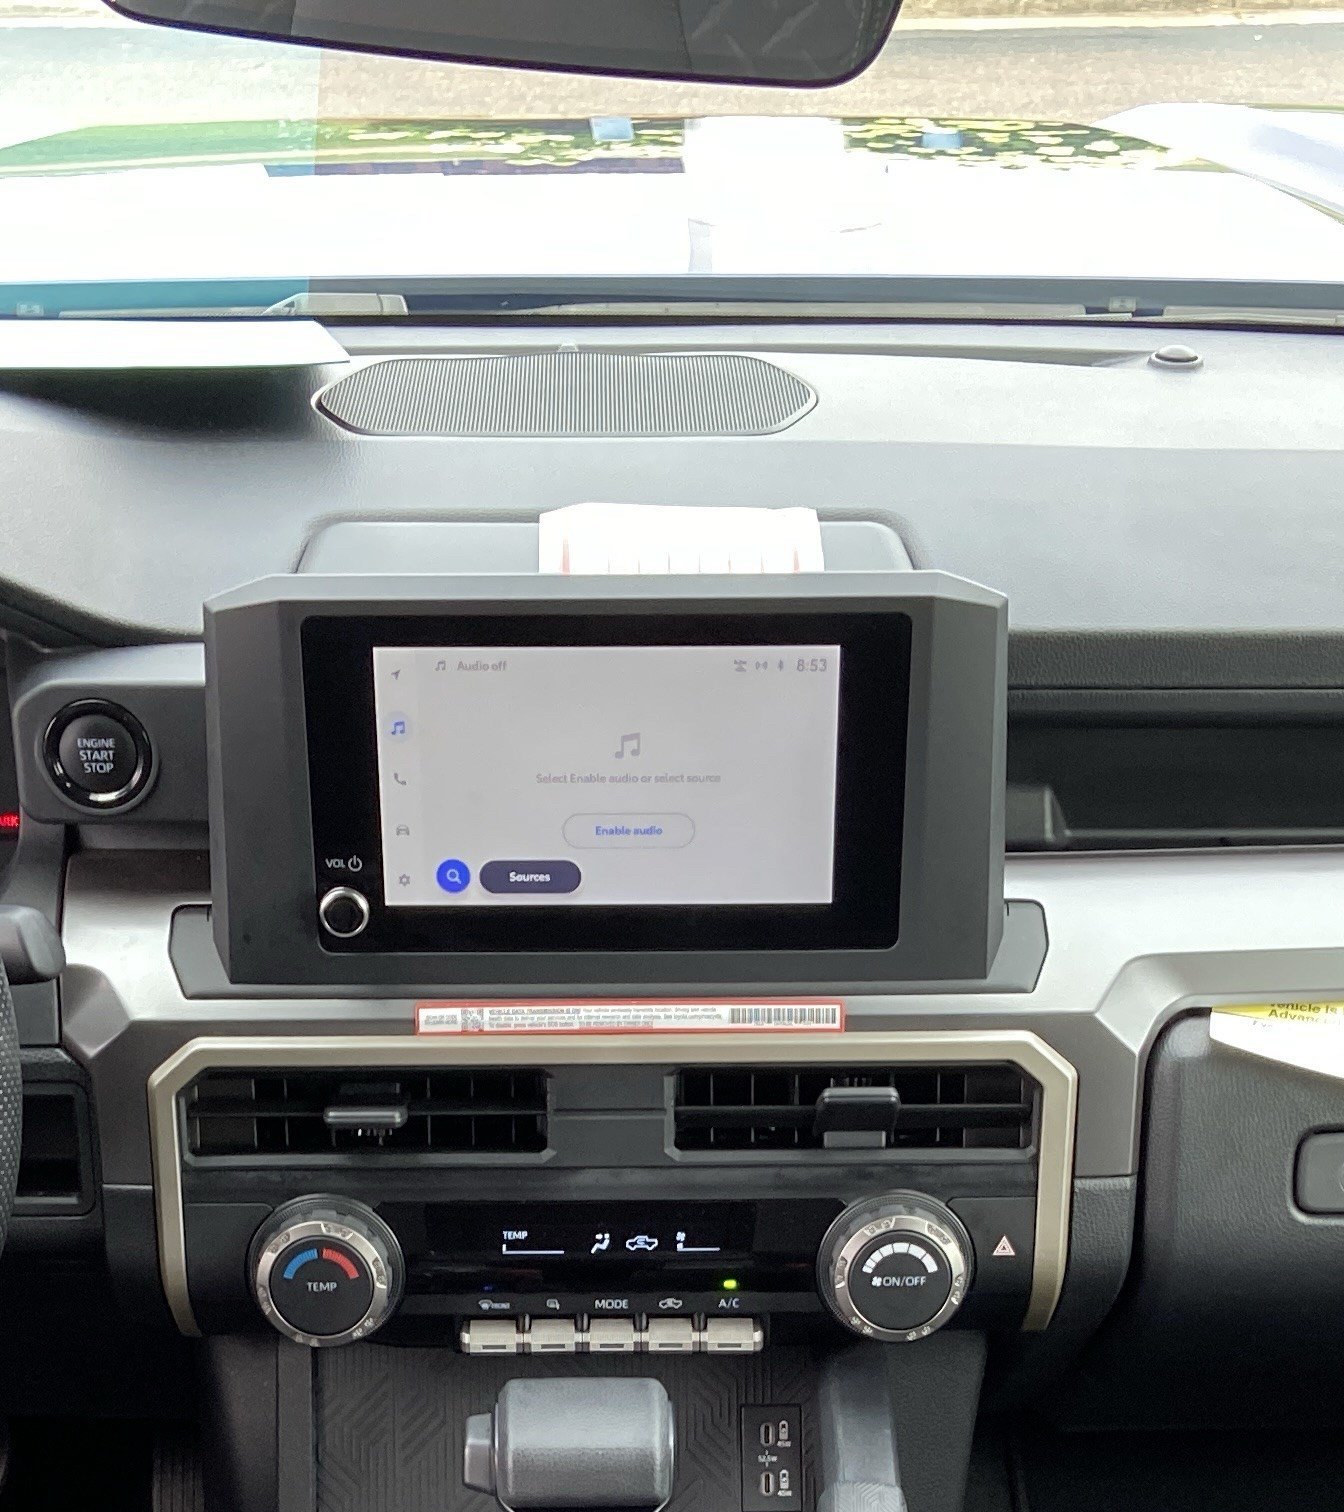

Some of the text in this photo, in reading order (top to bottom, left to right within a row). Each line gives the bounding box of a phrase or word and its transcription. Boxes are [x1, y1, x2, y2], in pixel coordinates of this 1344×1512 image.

[457, 660, 508, 671] Audio off
[77, 737, 116, 748] ENGINE
[79, 749, 115, 761] START
[83, 762, 114, 774] STOP
[536, 773, 721, 784] Select Enable audio or select source
[595, 825, 663, 836] Enable audio
[325, 858, 346, 868] VOL
[509, 871, 551, 883] Sources
[1270, 1003, 1321, 1013] ehicle
[503, 1230, 528, 1240] TEMP
[306, 1281, 338, 1293] TEMP
[883, 1276, 926, 1287] ON/OFF
[595, 1299, 628, 1309] MODE
[718, 1298, 740, 1308] A/C
